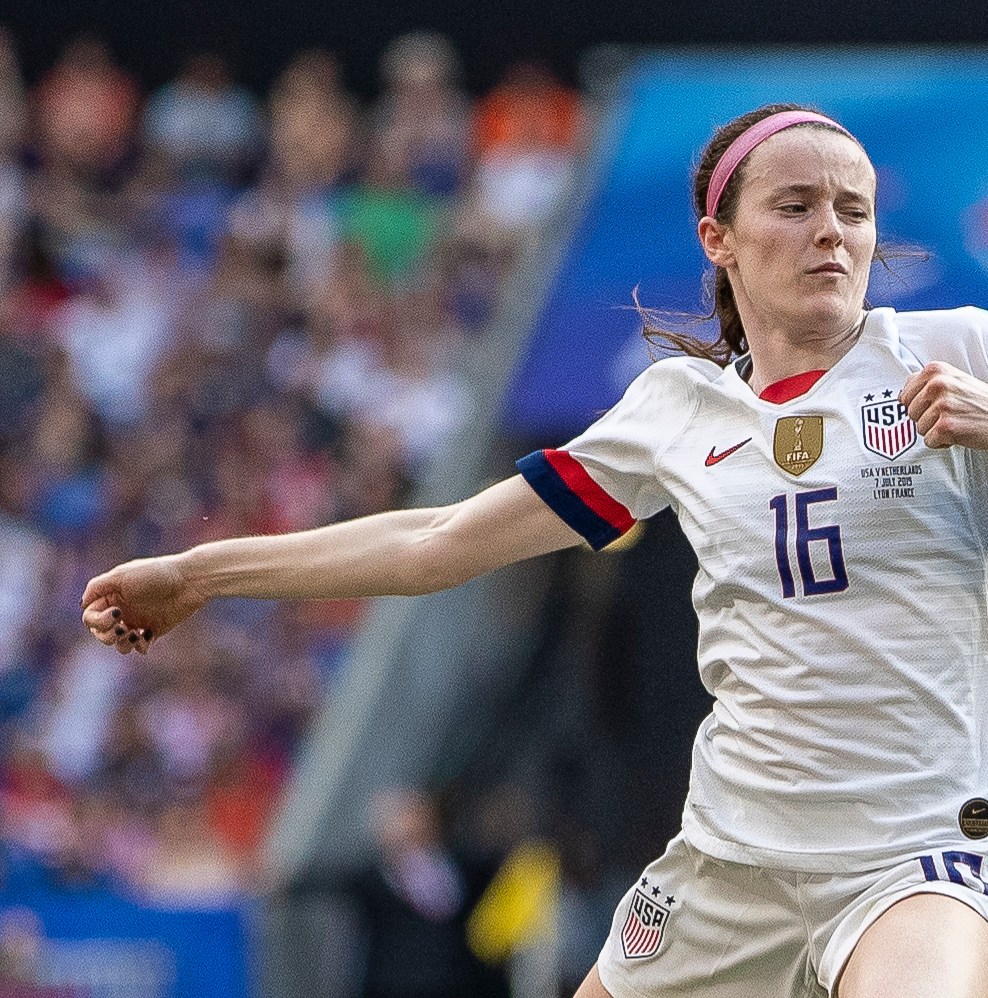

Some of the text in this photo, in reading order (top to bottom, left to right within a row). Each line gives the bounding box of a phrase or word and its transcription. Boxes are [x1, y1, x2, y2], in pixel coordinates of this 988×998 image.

[867, 404, 909, 426] USA
[786, 451, 809, 462] FIFA
[861, 467, 875, 478] USA
[881, 465, 923, 477] NETHERLANDS
[874, 478, 880, 488] 7
[881, 478, 896, 487] JULY
[873, 488, 915, 500] LYON FRANCE
[770, 487, 849, 599] 16
[633, 895, 665, 927] USA
